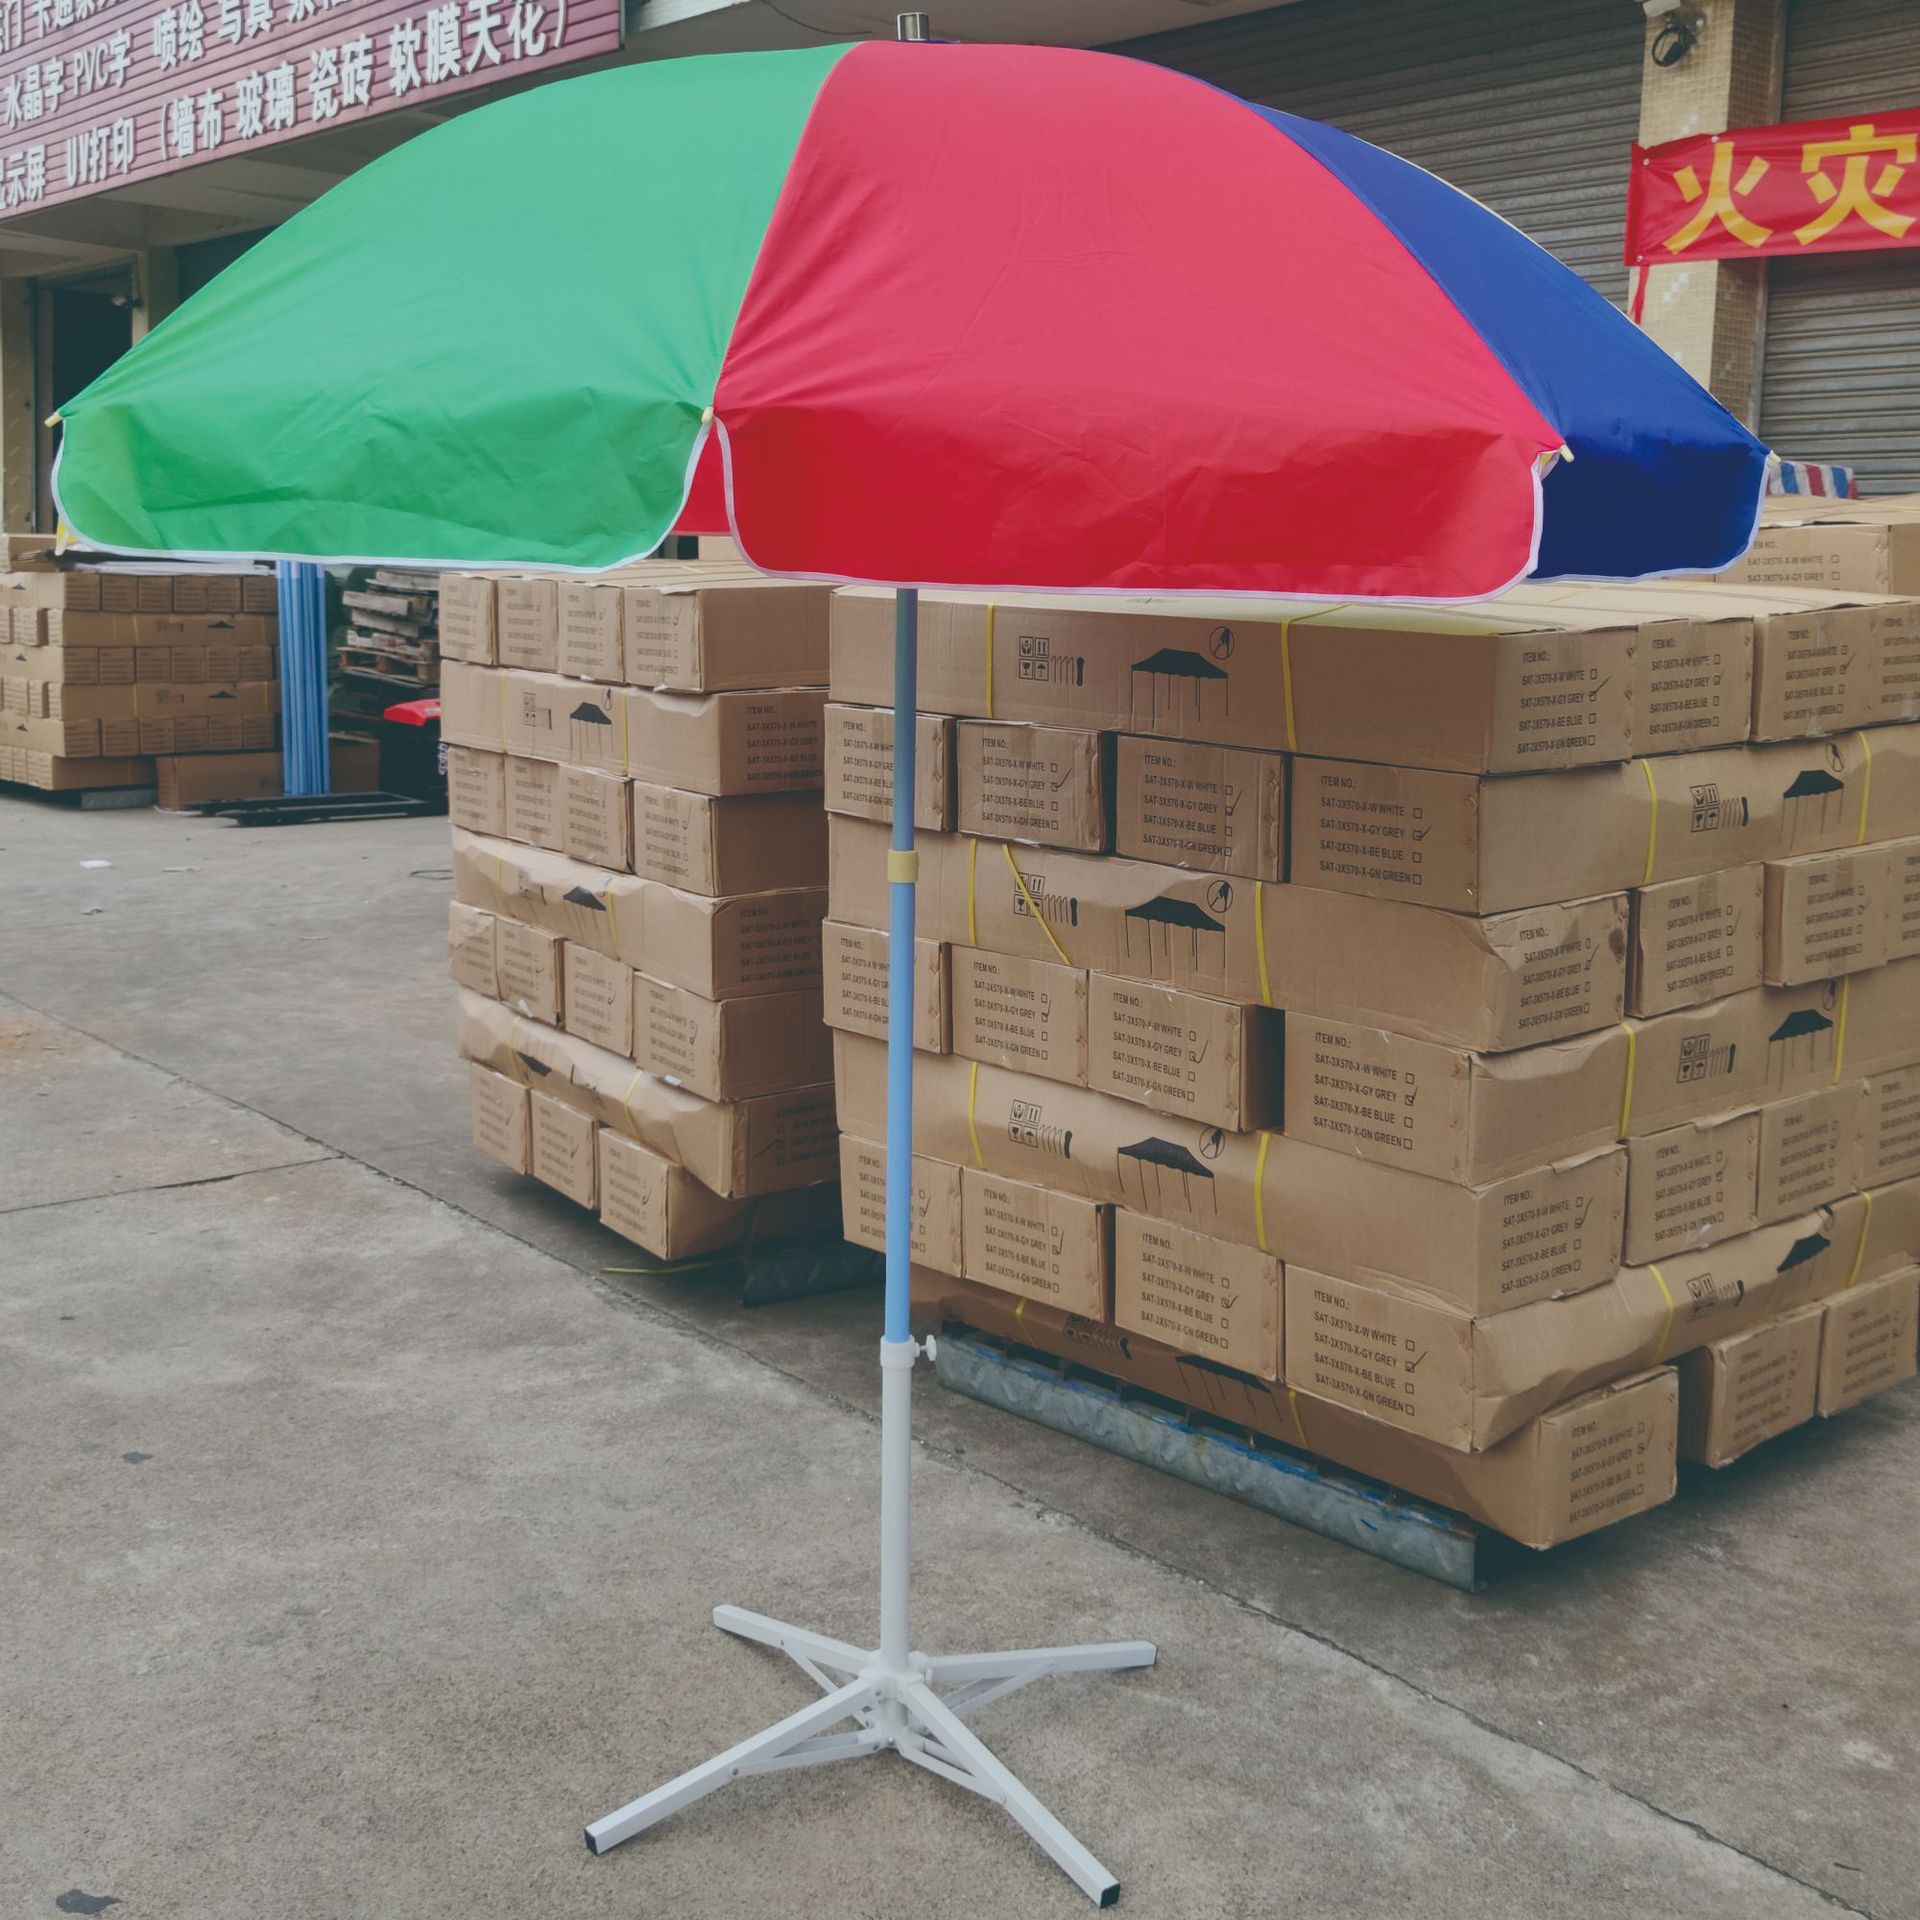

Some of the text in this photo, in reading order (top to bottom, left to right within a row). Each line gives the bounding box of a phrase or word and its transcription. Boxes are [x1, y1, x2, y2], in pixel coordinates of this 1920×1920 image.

[153, 1, 205, 71] 喷绘
[236, 61, 296, 140] 玻璃
[308, 33, 375, 121] 瓷砖
[1662, 124, 1918, 255] 火灾
[982, 738, 995, 748] ITEM
[1025, 761, 1044, 771] WHITE
[1145, 754, 1160, 765] ITEM
[1028, 780, 1045, 790] GREY
[1194, 781, 1217, 793] WHITE
[1321, 776, 1338, 787] ITEM
[1028, 799, 1044, 809] BLUE
[1197, 802, 1217, 813] GREY
[1378, 803, 1404, 816] WHITE
[1029, 818, 1050, 828] GREEN
[1197, 822, 1216, 834] BLUE
[1382, 826, 1405, 838] GREY
[1198, 843, 1222, 855] GREEN
[1381, 848, 1403, 860] BLUE
[1382, 870, 1411, 883] GREEN
[974, 962, 987, 972] ITEM
[1016, 988, 1034, 1000] WHITE
[1113, 992, 1128, 1004] ITEM
[1019, 1007, 1035, 1019] GREY
[1019, 1026, 1035, 1038] BLUE
[1161, 1023, 1182, 1037] WHITE
[1315, 1032, 1333, 1044] ITEM
[1020, 1044, 1040, 1058] GREEN
[1164, 1044, 1182, 1057] GREY
[1163, 1064, 1180, 1077] BLUE
[1372, 1065, 1397, 1080] WHITE
[1163, 1084, 1186, 1099] GREEN
[1374, 1087, 1397, 1101] GREY
[1374, 1109, 1395, 1124] BLUE
[1374, 1130, 1401, 1147] GREEN
[984, 1189, 996, 1200] ITEM
[1504, 1192, 1520, 1205] ITEM
[1143, 1233, 1158, 1246] ITEM
[1192, 1267, 1214, 1284] WHITE
[1195, 1289, 1214, 1304] GREY
[1315, 1290, 1332, 1305] ITEM
[1194, 1309, 1213, 1324] BLUE
[1195, 1329, 1219, 1346] GREEN
[1371, 1328, 1397, 1346] WHITE
[1375, 1351, 1397, 1367] GREY
[1375, 1372, 1396, 1389] BLUE
[1377, 1393, 1404, 1412] GREEN
